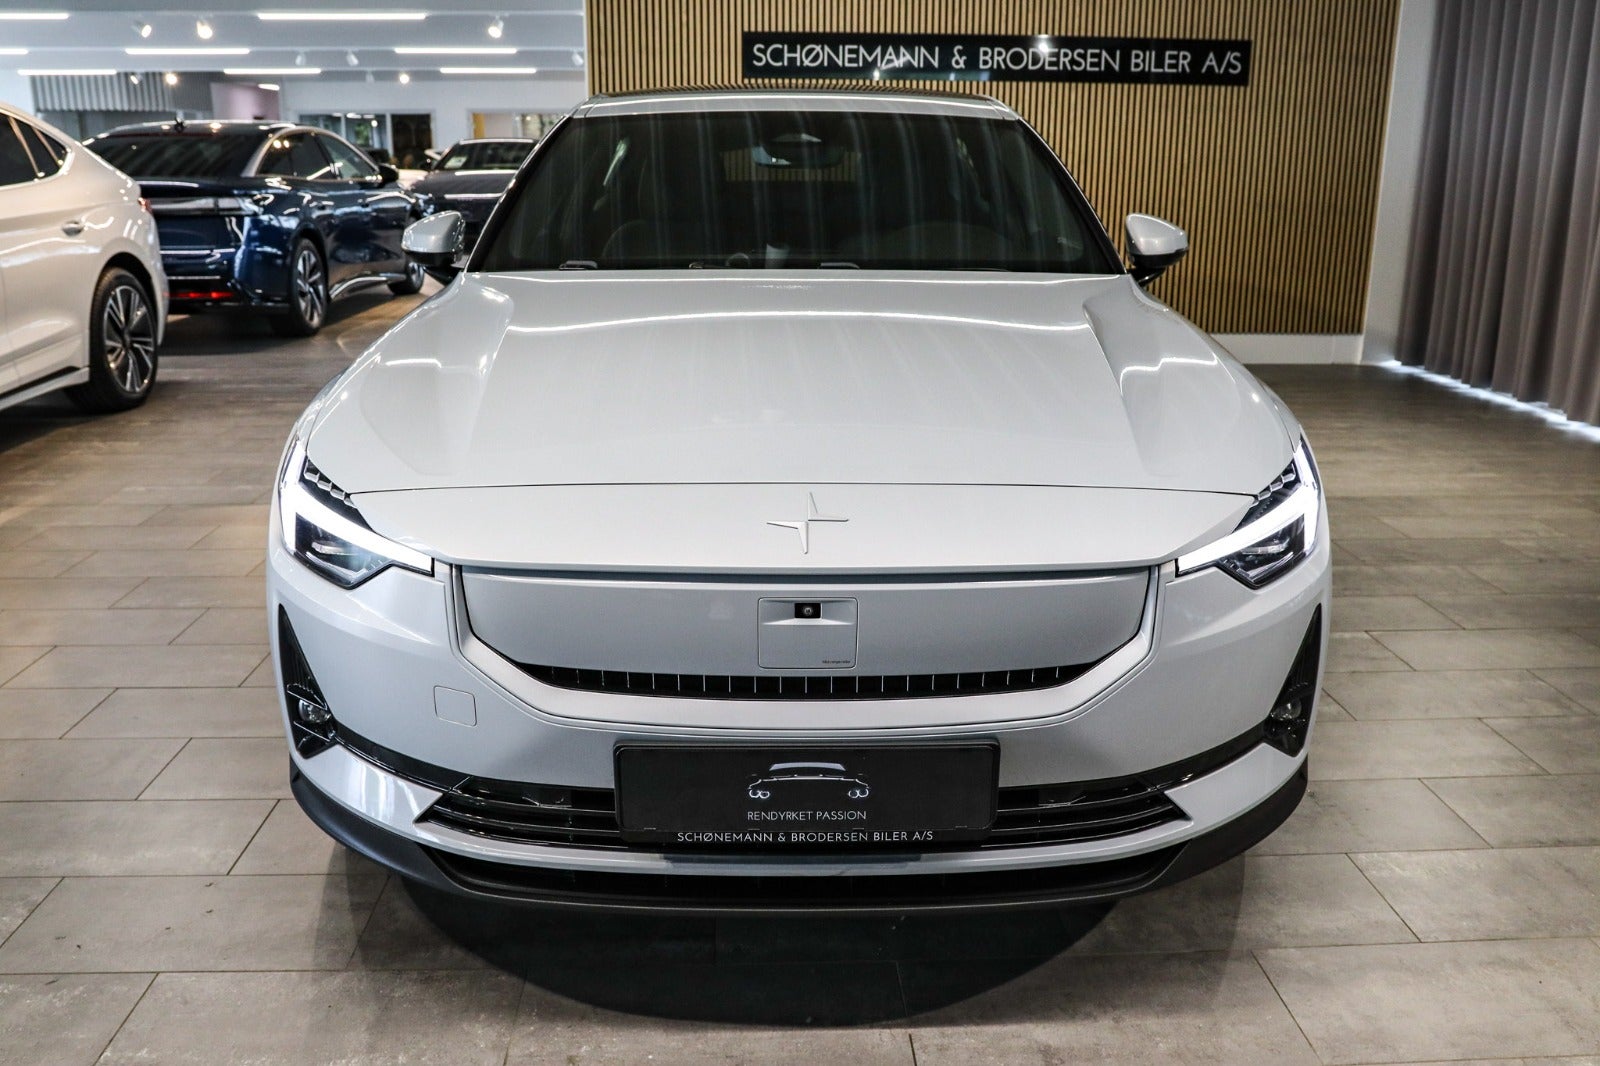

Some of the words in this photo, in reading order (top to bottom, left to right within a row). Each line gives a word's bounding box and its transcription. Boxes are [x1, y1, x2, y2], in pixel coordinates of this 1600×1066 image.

[752, 43, 939, 69] SCHØNEMANN
[950, 45, 967, 68] &
[979, 47, 1120, 71] BRODERSEN
[1130, 50, 1191, 73] BILER
[1201, 52, 1243, 75] A/S
[747, 811, 813, 821] RENDYRKET
[816, 810, 867, 820] PASSION
[677, 832, 773, 842] SCHØNEMANN
[777, 832, 786, 842] &
[791, 832, 868, 842] BRODERSEN
[873, 831, 908, 841] BILER
[912, 830, 934, 842] A/S
